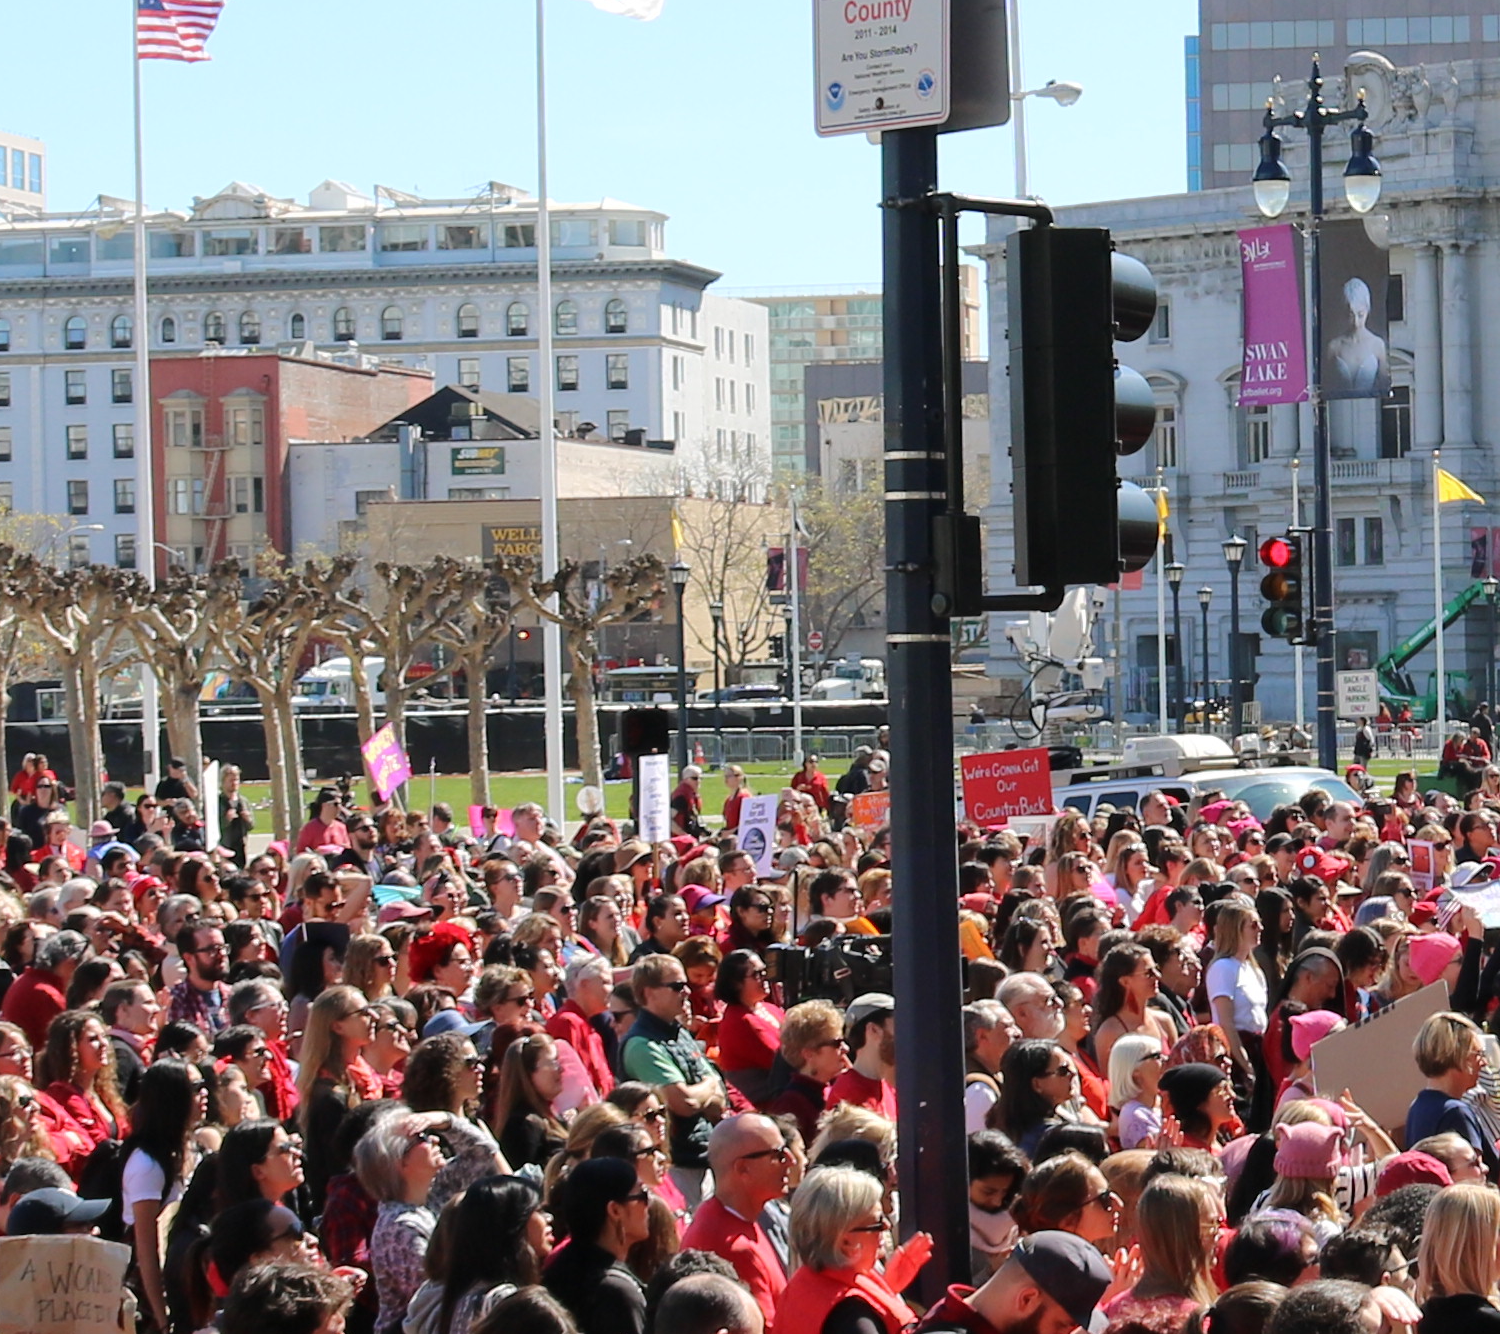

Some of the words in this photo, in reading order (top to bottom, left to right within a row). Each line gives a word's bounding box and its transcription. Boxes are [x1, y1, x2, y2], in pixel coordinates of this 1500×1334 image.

[855, 29, 872, 40] 2011
[880, 25, 897, 37] 2014
[842, 53, 853, 62] Are
[855, 51, 868, 60] You
[870, 43, 918, 59] StormReady?
[1245, 341, 1288, 361] SWAN
[1245, 362, 1287, 382] LAKE
[491, 528, 542, 540] WELL
[493, 543, 542, 556] FARG
[997, 780, 1017, 793] Our
[21, 1260, 36, 1282] A
